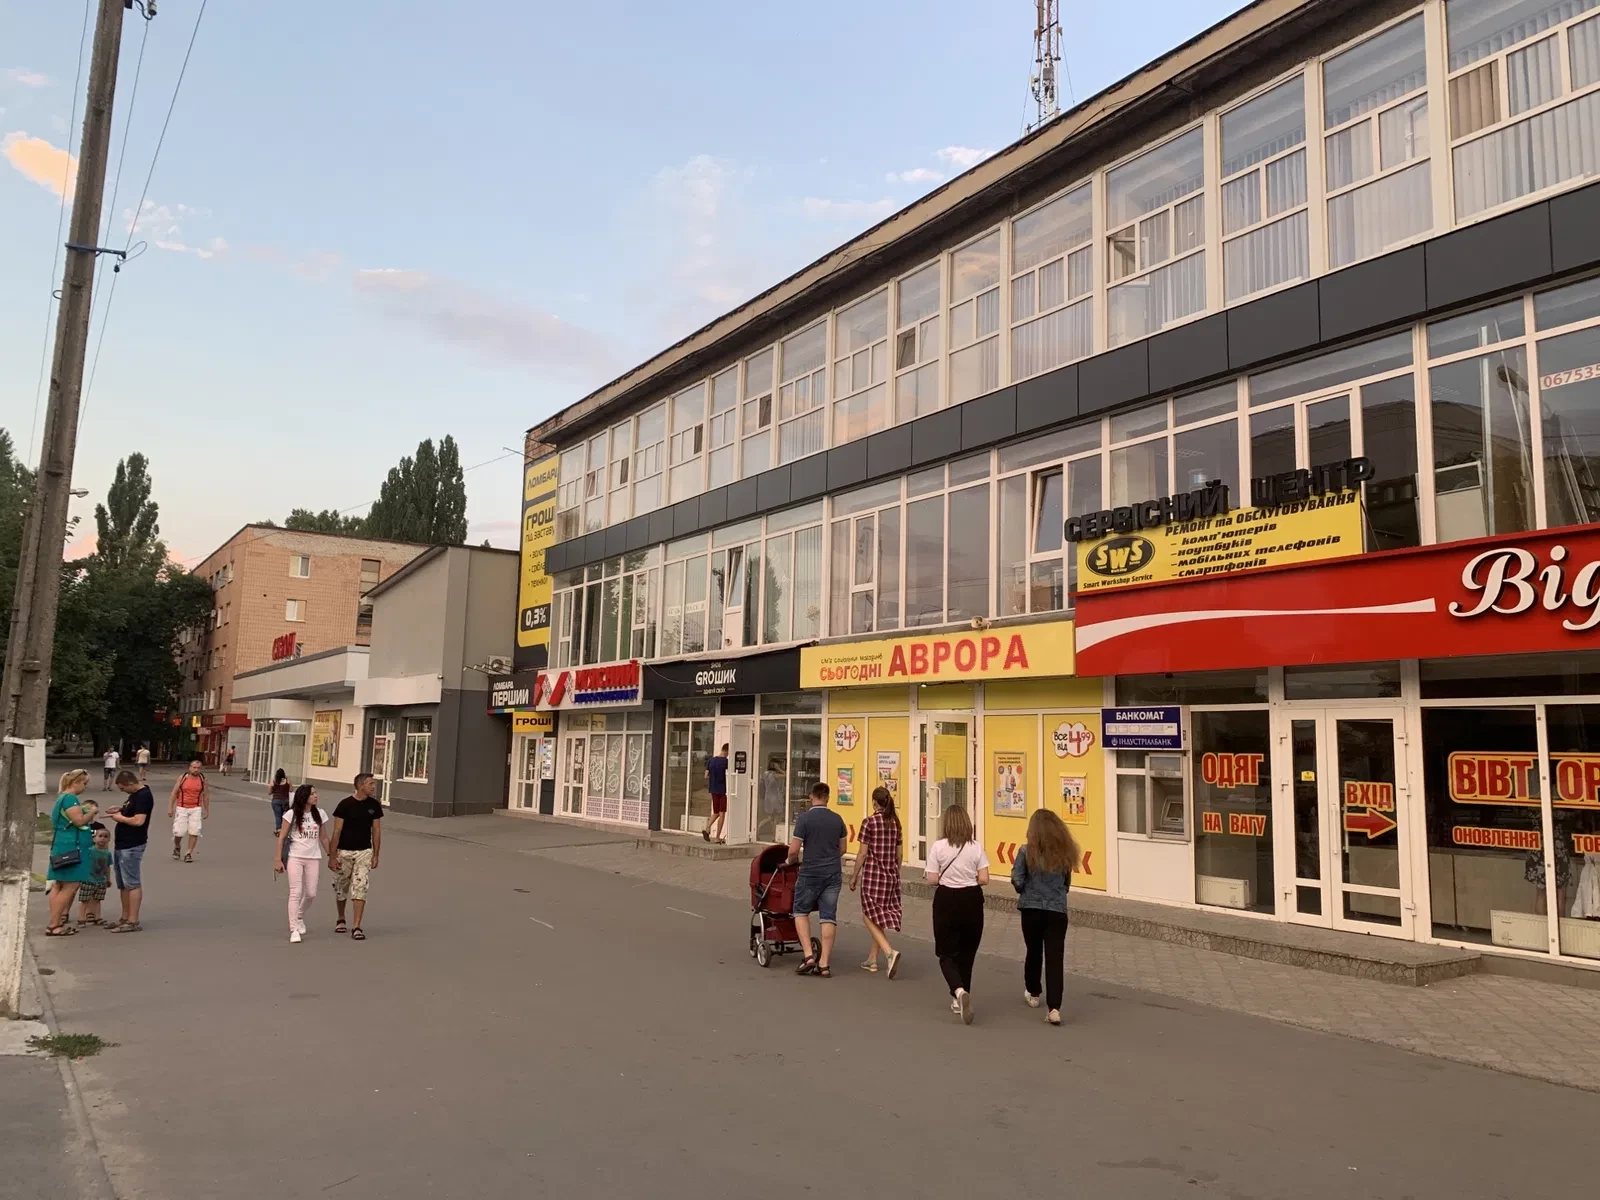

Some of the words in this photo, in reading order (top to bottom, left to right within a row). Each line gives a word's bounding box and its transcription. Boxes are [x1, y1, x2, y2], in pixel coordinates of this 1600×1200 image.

[1064, 479, 1229, 542] СЕРВІСНИЙ
[1251, 456, 1375, 508] ЦЕНТР
[1165, 519, 1212, 536] РЕМОНТ
[1236, 492, 1356, 525] ОБСЛУГОВУВАННЯ
[1254, 535, 1341, 556] телефонів
[1083, 580, 1100, 589] Smart
[1101, 576, 1130, 587] Workshop
[1131, 573, 1153, 583] Service
[525, 606, 547, 628] 0,3%
[820, 664, 882, 681] СЬОГОДНІ
[888, 634, 1029, 677] АВРОРА
[515, 717, 551, 726] ГРОШІ
[1115, 711, 1165, 721] БАНКОМАТ
[1202, 752, 1264, 788] ОДЯГ
[1344, 781, 1394, 811] ВХІД
[299, 829, 318, 839] SMILE
[1203, 812, 1223, 833] НА
[1229, 813, 1266, 836] ВАГУ
[1452, 826, 1541, 850] ОНОВЛЕННЯ
